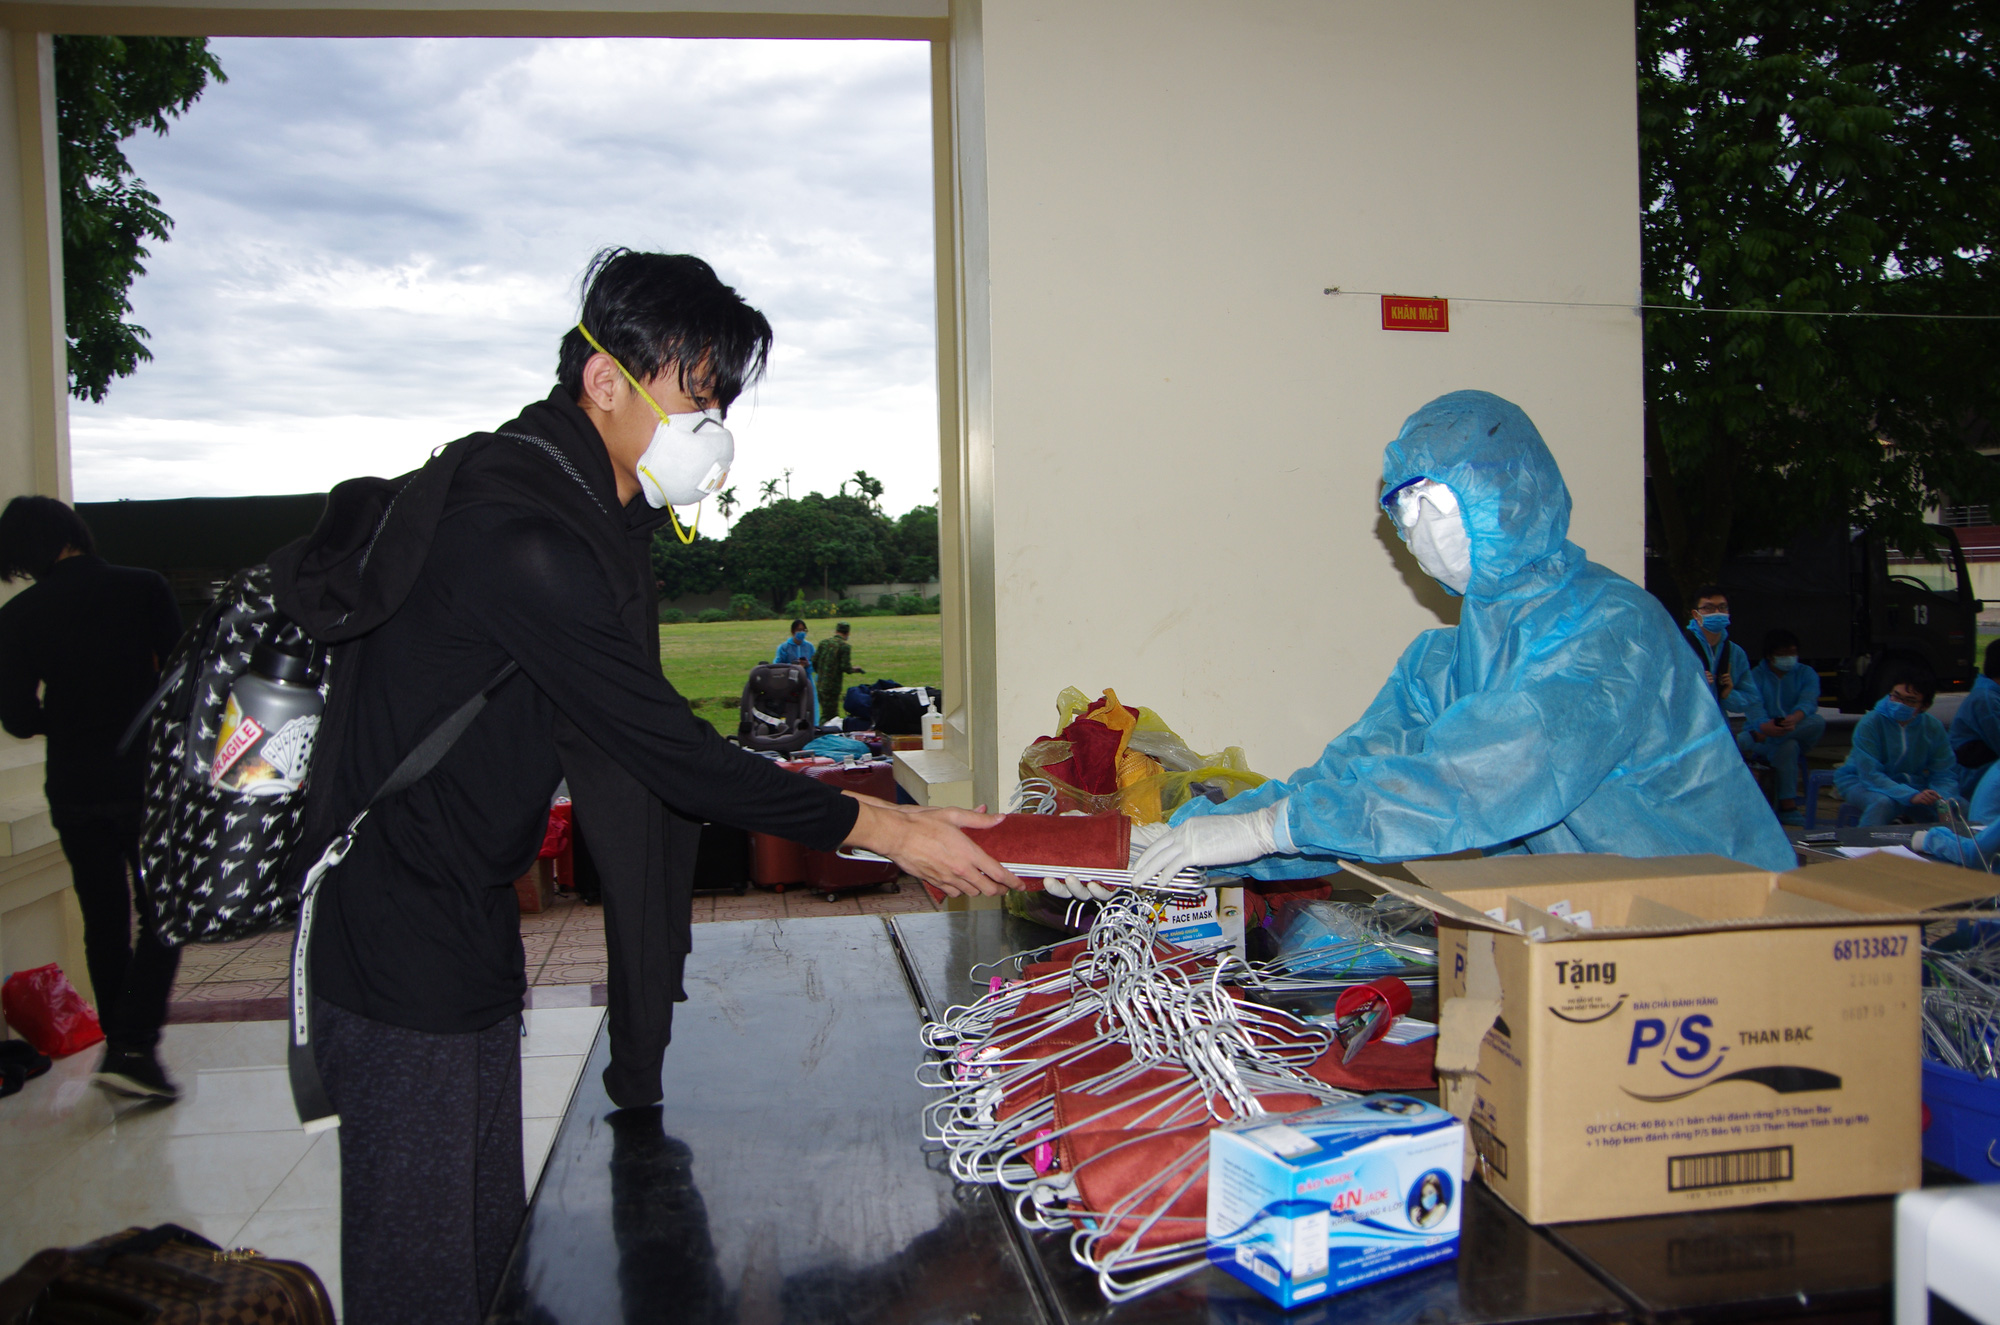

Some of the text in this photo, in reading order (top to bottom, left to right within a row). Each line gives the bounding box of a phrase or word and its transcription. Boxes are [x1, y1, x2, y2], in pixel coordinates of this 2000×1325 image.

[1391, 304, 1439, 324] KHĂN MẶT
[1913, 604, 1928, 625] 13
[210, 723, 256, 780] FRAGILE
[1172, 910, 1213, 924] FACE MASK
[1833, 936, 1908, 961] 68133827
[1555, 959, 1617, 989] Tặng
[1633, 1000, 1650, 1011] BÀN
[1672, 998, 1694, 1008] ĐÁNH
[1696, 997, 1718, 1007] RĂNG
[1627, 1014, 1714, 1066] P/S
[1739, 1025, 1814, 1046] THAN BẠC
[1586, 1125, 1607, 1135] QUY
[1641, 1120, 1652, 1130] 40
[1792, 1106, 1814, 1116] Than
[1623, 1136, 1644, 1145] kem
[1695, 1128, 1709, 1138] P/S
[1745, 1124, 1761, 1133] 123
[1764, 1122, 1785, 1132] Than
[1297, 1178, 1321, 1194] BẢO
[1331, 1187, 1388, 1212] 4N JADE
